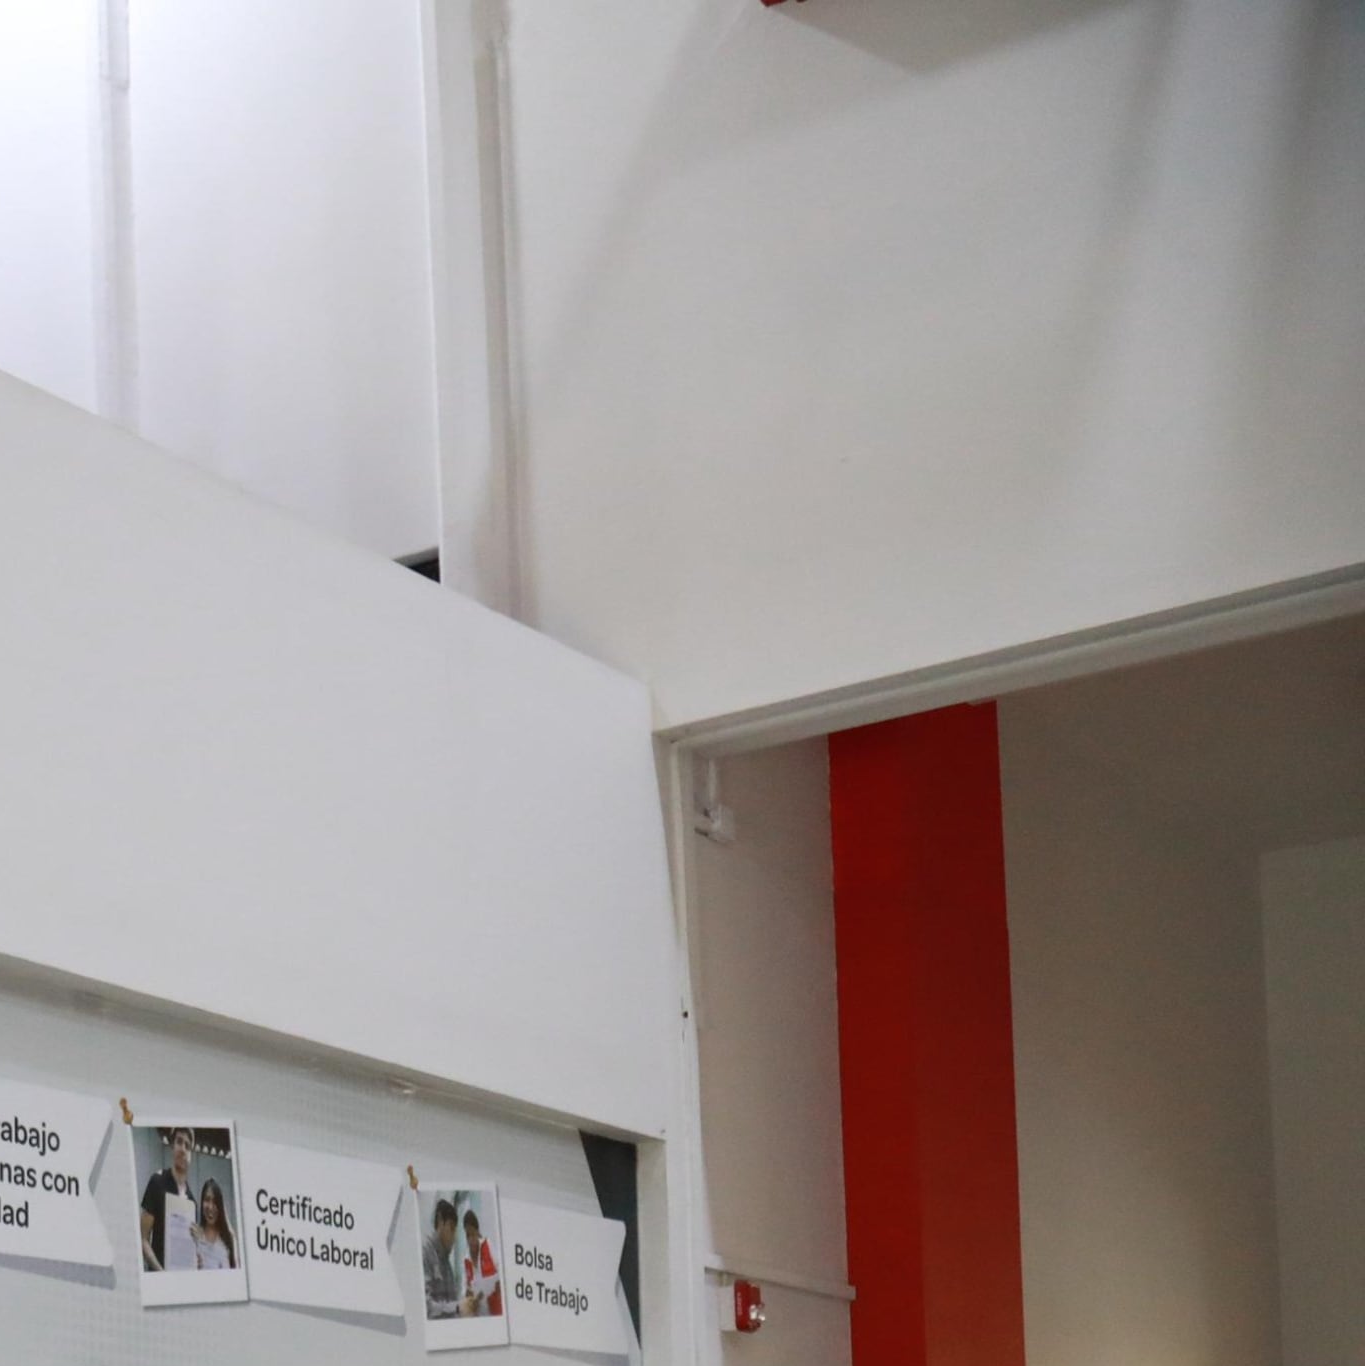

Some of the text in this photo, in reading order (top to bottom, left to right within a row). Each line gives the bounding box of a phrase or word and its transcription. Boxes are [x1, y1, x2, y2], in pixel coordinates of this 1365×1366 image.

[41, 1170, 80, 1197] con
[256, 1188, 355, 1231] Certificado
[256, 1219, 374, 1271] Único Laboral
[515, 1243, 554, 1272] Bolsa
[515, 1277, 589, 1316] de Trabajo
